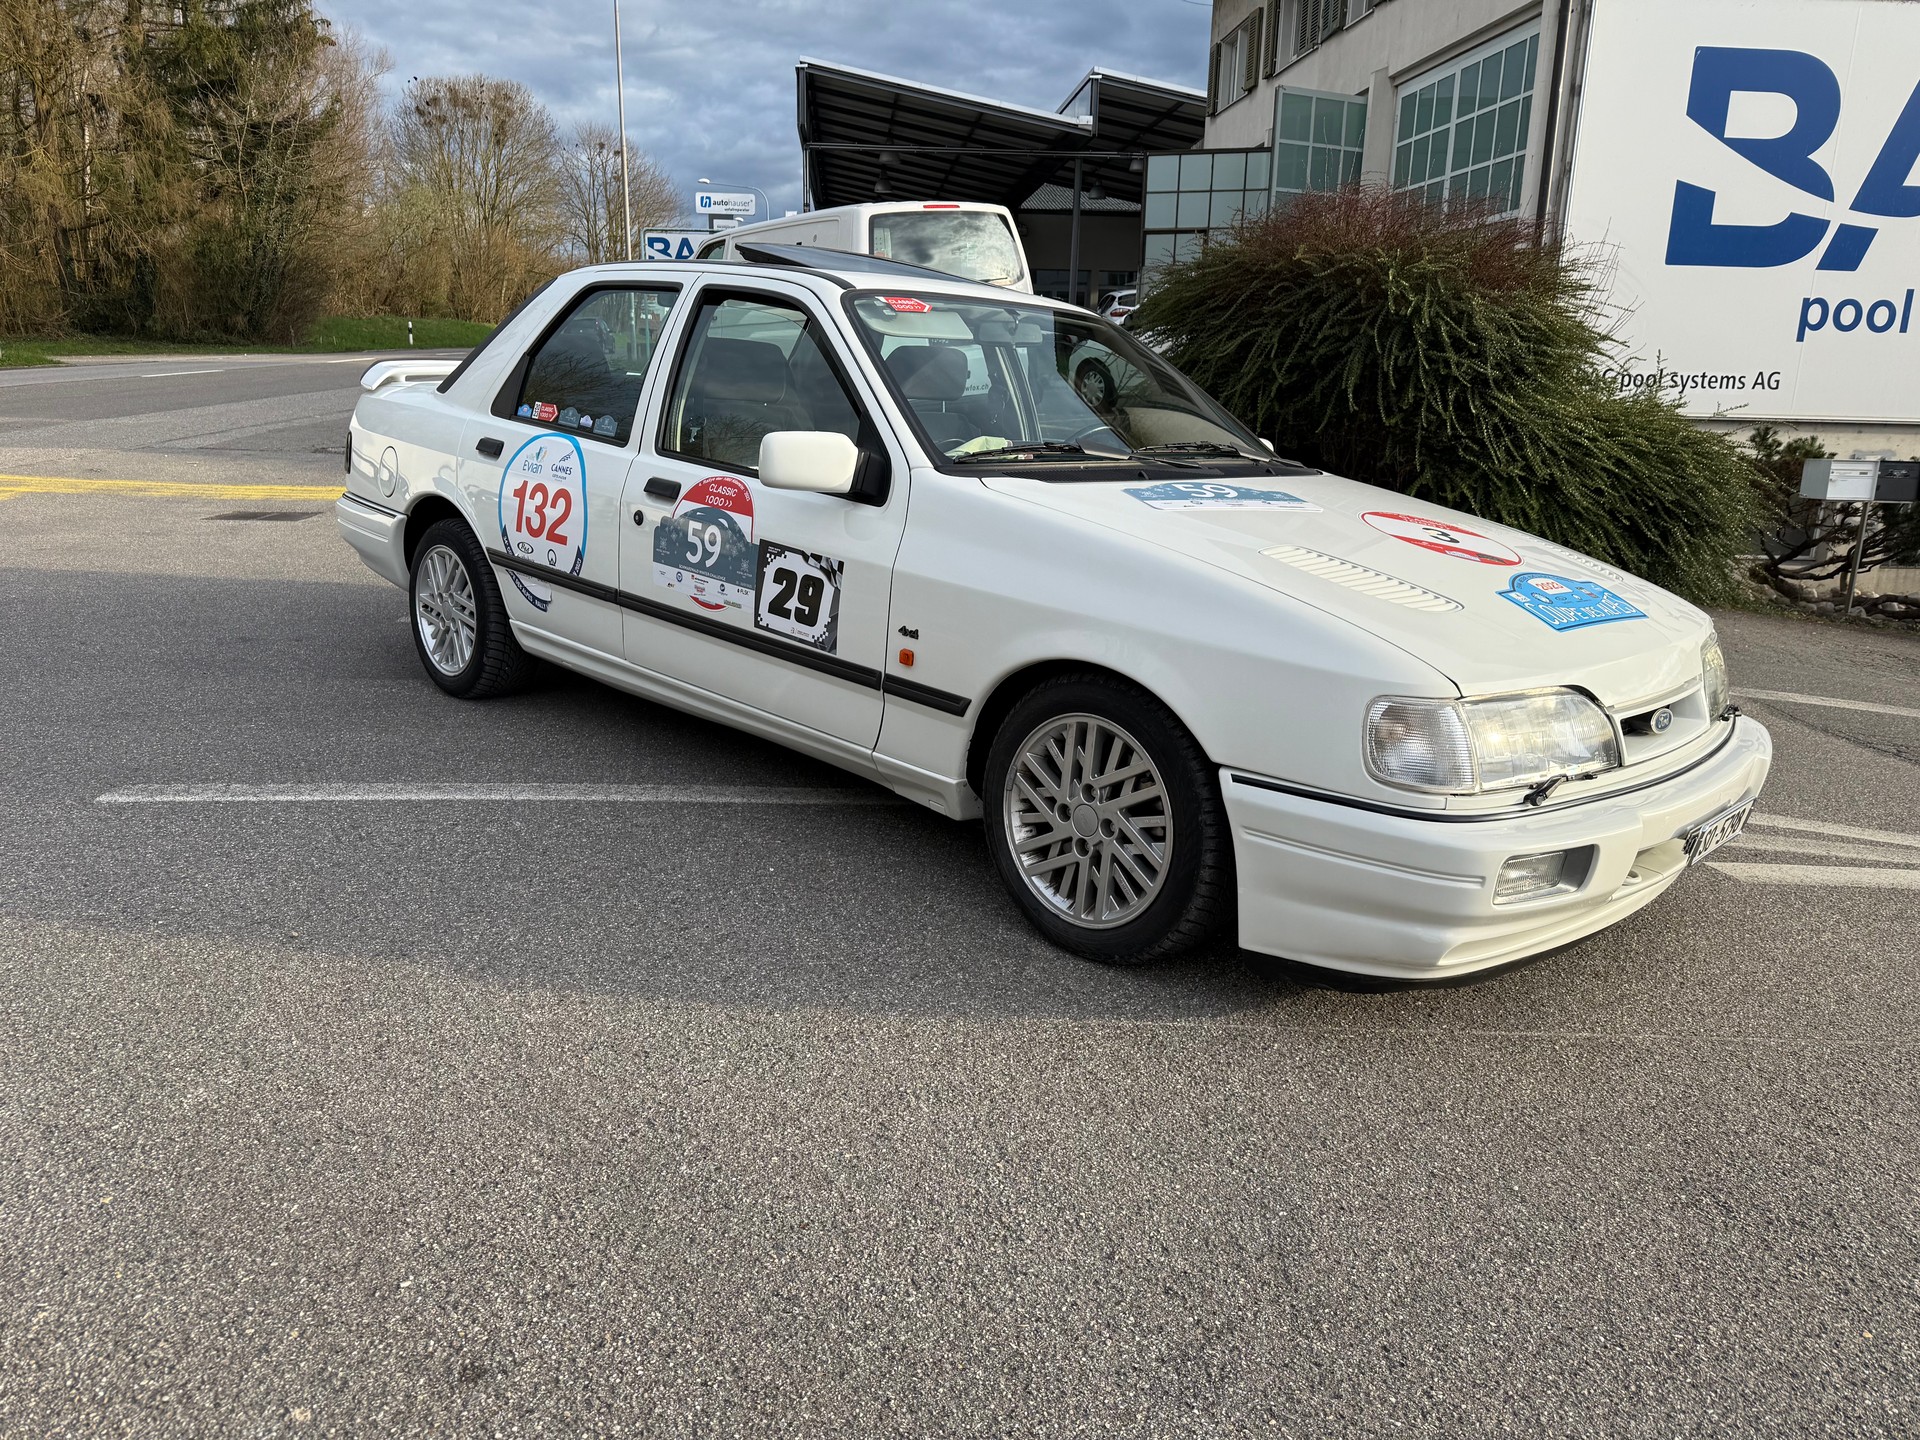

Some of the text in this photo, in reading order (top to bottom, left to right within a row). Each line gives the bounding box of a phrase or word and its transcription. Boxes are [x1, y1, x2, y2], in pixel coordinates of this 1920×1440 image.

[1795, 289, 1915, 342] pool
[1619, 368, 1664, 393] pool
[1670, 371, 1747, 394] systems
[1752, 371, 1781, 390] AG
[551, 463, 573, 475] CANNES
[705, 495, 725, 507] 1000
[709, 483, 738, 498] CLASSIC
[1171, 483, 1239, 499] 59
[512, 480, 572, 546] 132
[685, 519, 722, 568] 59
[1422, 527, 1460, 543] 3
[767, 567, 825, 628] 29
[1524, 602, 1585, 625] COUPE
[1581, 605, 1605, 618] DES
[1597, 592, 1638, 616] ALPES
[898, 625, 919, 640] 4x4
